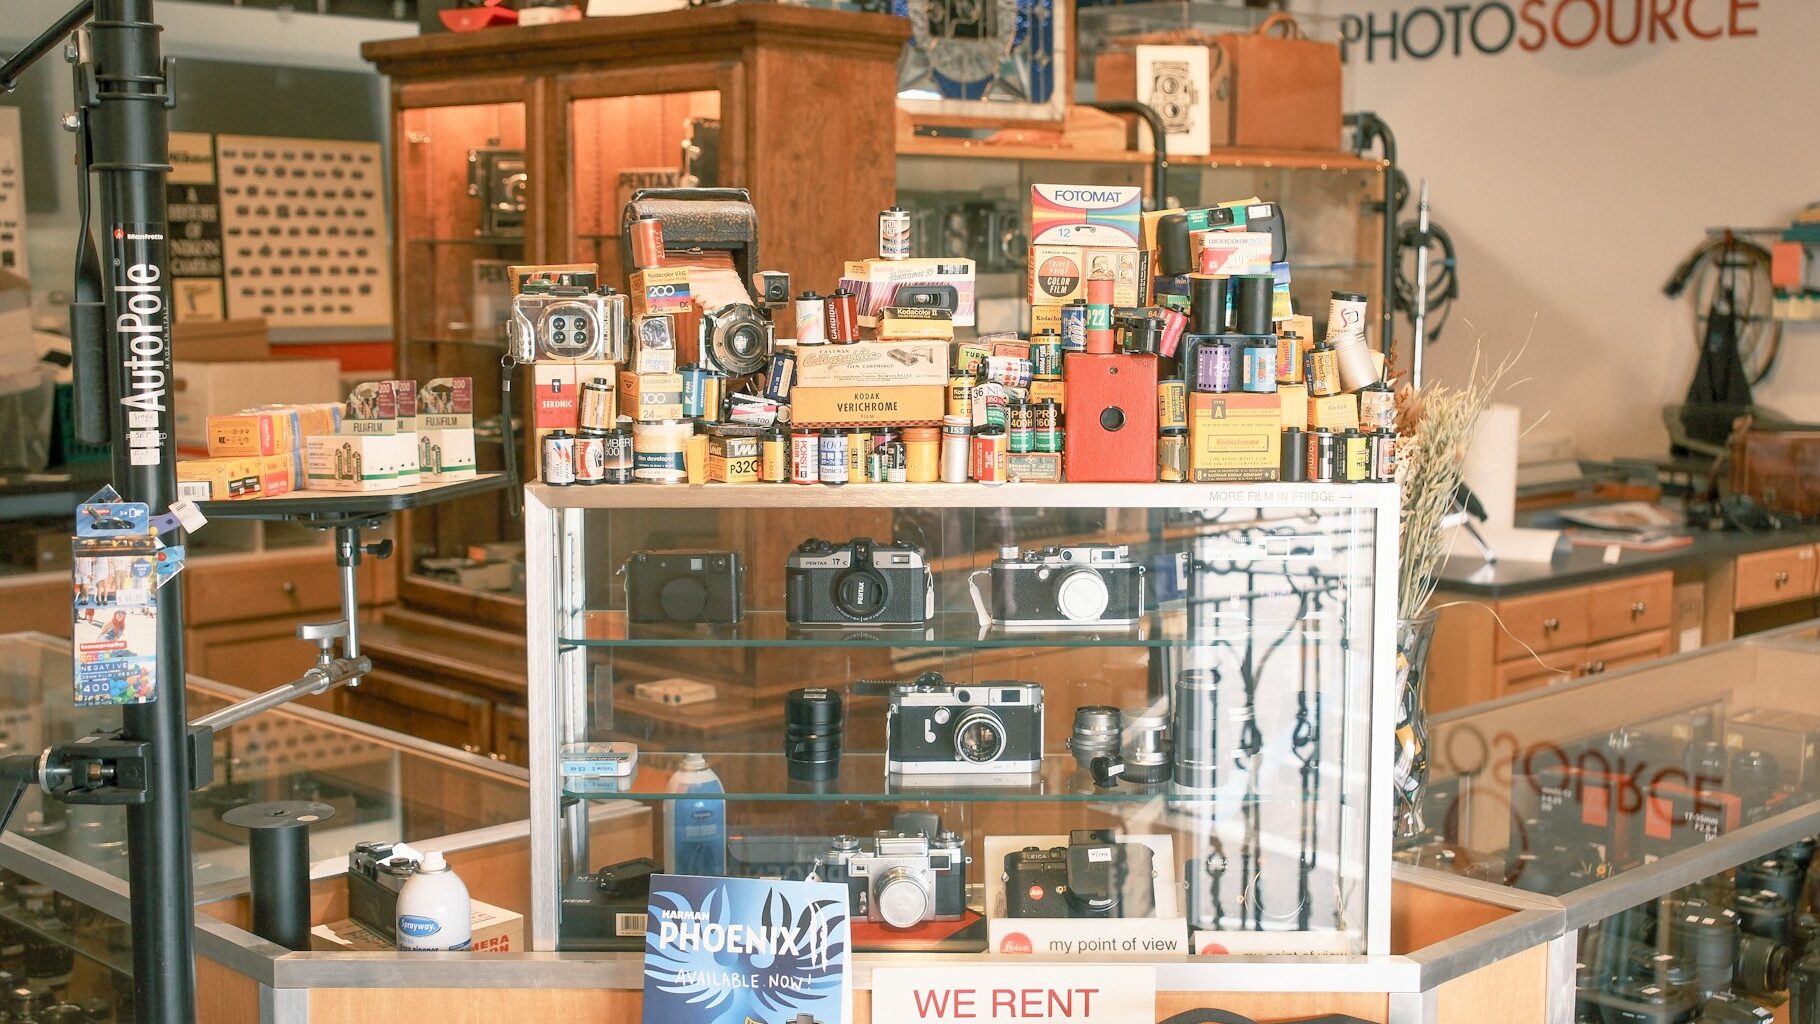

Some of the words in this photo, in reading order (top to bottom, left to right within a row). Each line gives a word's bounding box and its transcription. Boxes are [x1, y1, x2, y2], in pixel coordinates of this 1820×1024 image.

[1055, 190, 1122, 203] FOTOMAT
[1058, 228, 1070, 238] 12
[889, 271, 925, 281] Panoramic
[1046, 277, 1070, 286] COLOR
[649, 285, 675, 297] 200
[1049, 285, 1068, 294] FILM
[652, 304, 664, 314] 24
[1071, 314, 1087, 344] 200
[114, 263, 167, 412] AutoPole
[453, 379, 466, 389] 200
[854, 392, 880, 400] KODAK
[973, 387, 984, 398] 36
[542, 400, 573, 408] SEKONIC
[643, 393, 666, 404] 100
[837, 401, 898, 412] VERICHROME
[1214, 405, 1223, 418] A
[643, 410, 656, 418] 24
[1011, 409, 1033, 418] PRO
[1036, 409, 1057, 418] PRO
[425, 416, 458, 426] FUJIFILM
[1011, 418, 1033, 427] 400H
[353, 422, 383, 432] FUJIFILM
[605, 437, 631, 448] MBER
[731, 440, 757, 456] TMA
[800, 440, 808, 468] PORST
[1209, 491, 1244, 502] MORE
[1247, 491, 1274, 502] FILM
[1277, 491, 1289, 502] IN
[1292, 491, 1336, 502] FRIDGE
[832, 558, 841, 566] 17
[857, 581, 865, 605] PENTAX
[80, 653, 110, 662] COLOR
[81, 663, 128, 672] NEGATIVE
[83, 683, 110, 693] 400
[662, 909, 711, 921] HARMAN
[401, 918, 437, 933] Sprayway
[471, 934, 510, 952] MERA
[659, 921, 802, 956] PHOENIX
[1050, 938, 1073, 955] my
[1077, 936, 1118, 955] point
[1122, 936, 1138, 951] of
[1142, 938, 1178, 951] view
[675, 967, 760, 989] AVAILABLE
[769, 972, 812, 991] NOW!
[913, 989, 977, 1019] WE
[992, 988, 1100, 1018] RENT
